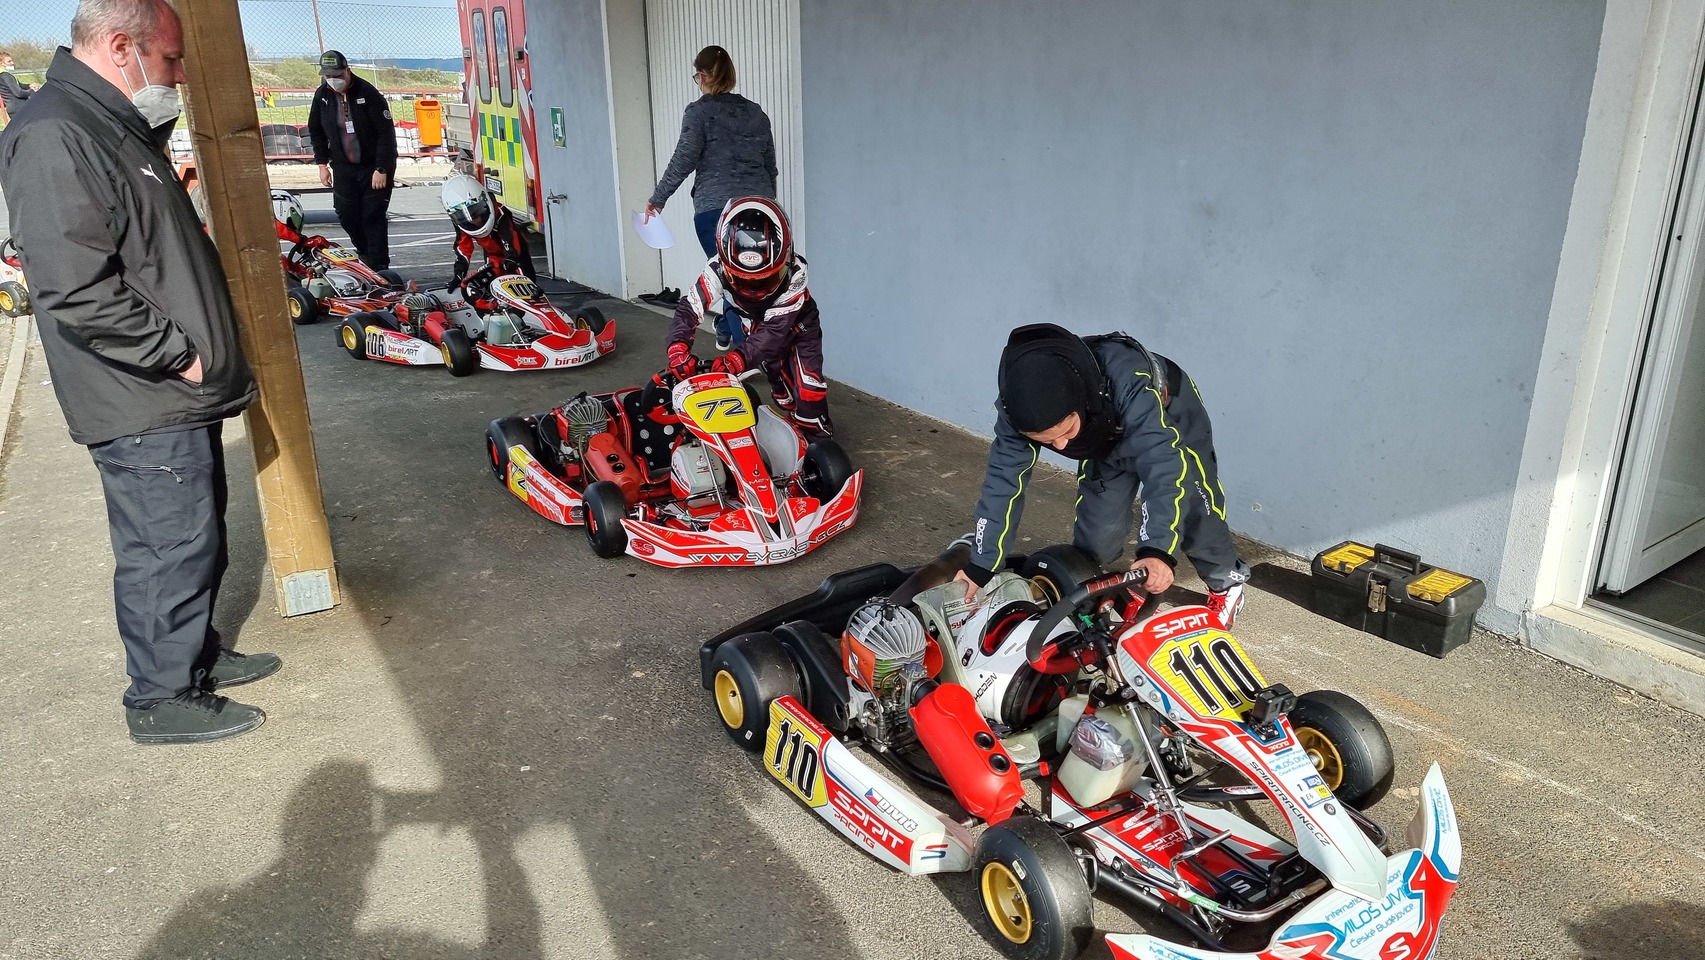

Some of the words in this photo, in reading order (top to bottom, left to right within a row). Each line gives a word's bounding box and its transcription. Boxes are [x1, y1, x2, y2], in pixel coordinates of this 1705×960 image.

[555, 350, 595, 366] birelART
[696, 397, 748, 421] 72
[1151, 612, 1210, 639] SPIRIT
[1168, 637, 1266, 715] 110
[773, 717, 819, 801] 110
[833, 789, 905, 849] SPIRIT
[877, 790, 919, 832] DIVIČ
[1250, 761, 1331, 847] SPIRITRACING.CZ
[832, 808, 876, 850] RACING
[1324, 897, 1363, 922] Internatio
[1386, 869, 1403, 885] sport
[1332, 902, 1381, 939] MILOŠ
[1349, 928, 1376, 949] České
[1375, 903, 1415, 933] Budějovice
